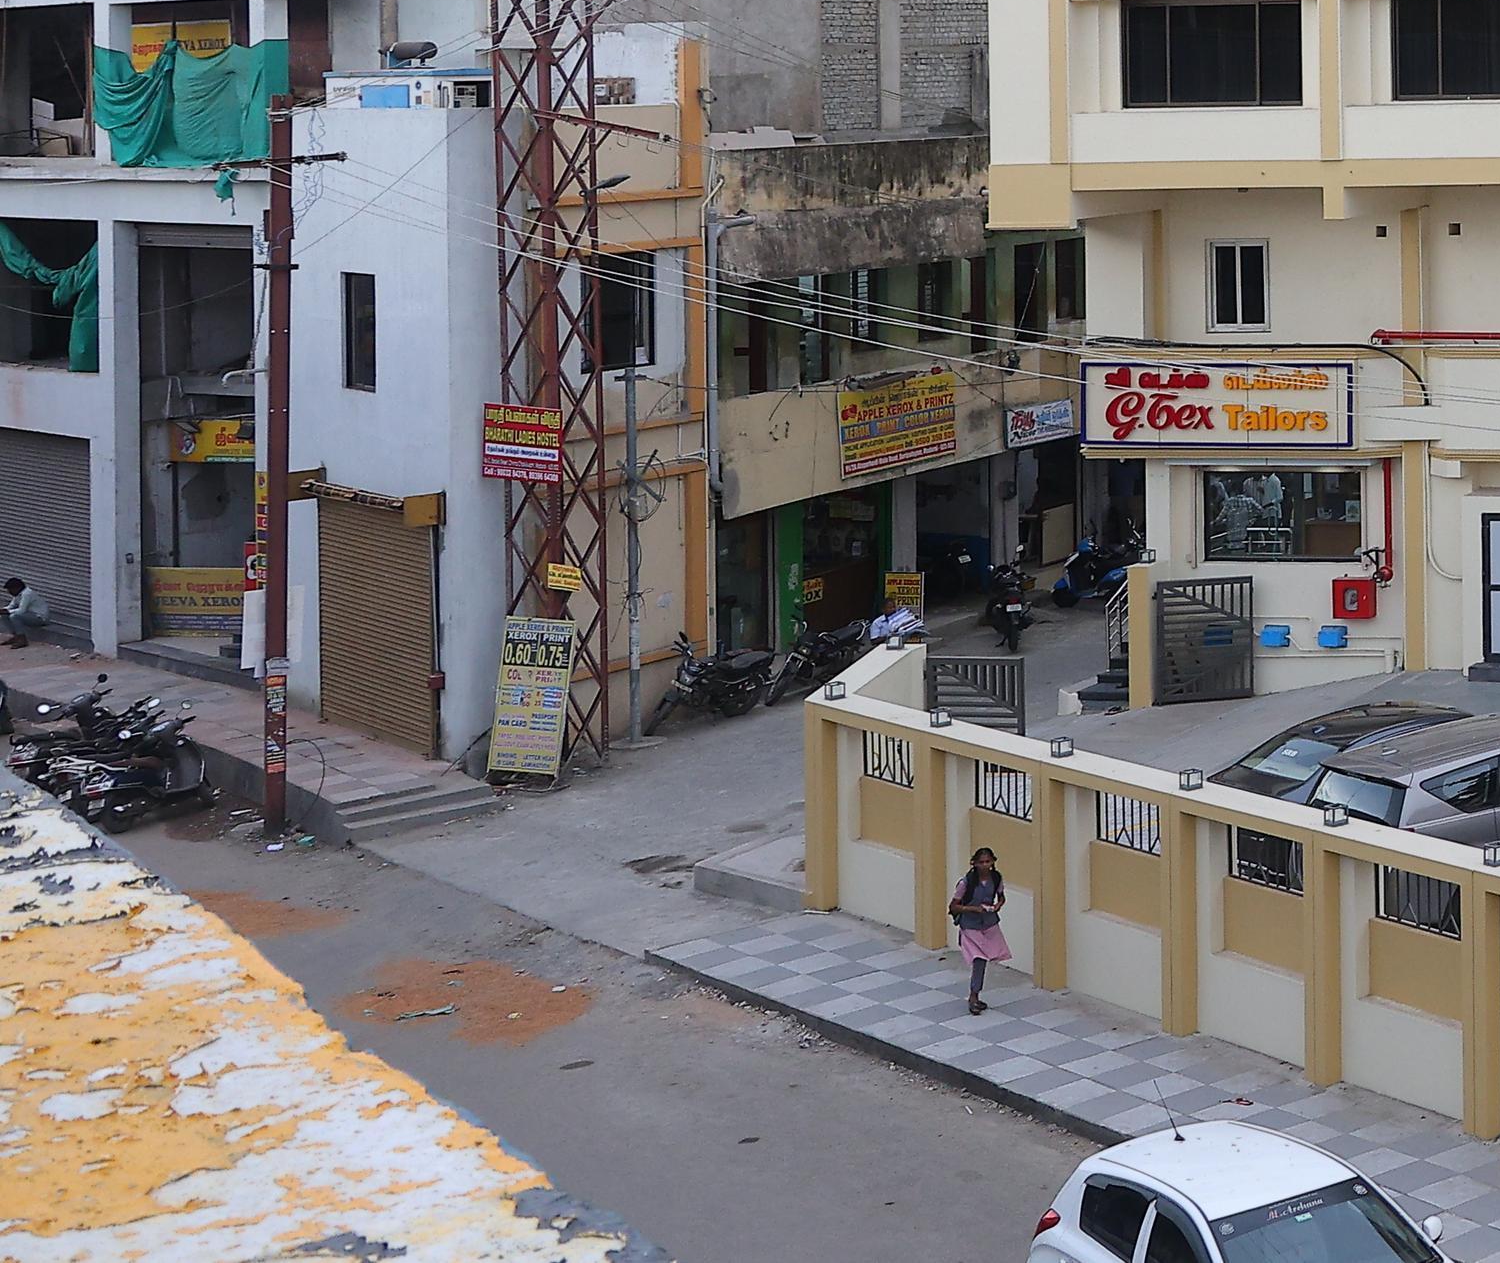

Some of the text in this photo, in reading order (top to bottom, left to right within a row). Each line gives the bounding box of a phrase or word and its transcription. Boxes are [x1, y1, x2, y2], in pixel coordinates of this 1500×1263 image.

[857, 393, 954, 422] APPLE XEROX & PRINTZ
[1222, 404, 1329, 431] Tailors
[845, 406, 954, 439] XEROX PRINT COLOR XEROX
[485, 426, 560, 447] BHARATHI LADIES HOSTEL
[896, 597, 920, 607] PRINT
[507, 622, 527, 630] APPLE
[507, 631, 570, 643] XEROX PRINT
[504, 642, 564, 667] 0.60 0.75
[510, 719, 527, 727] CARD
